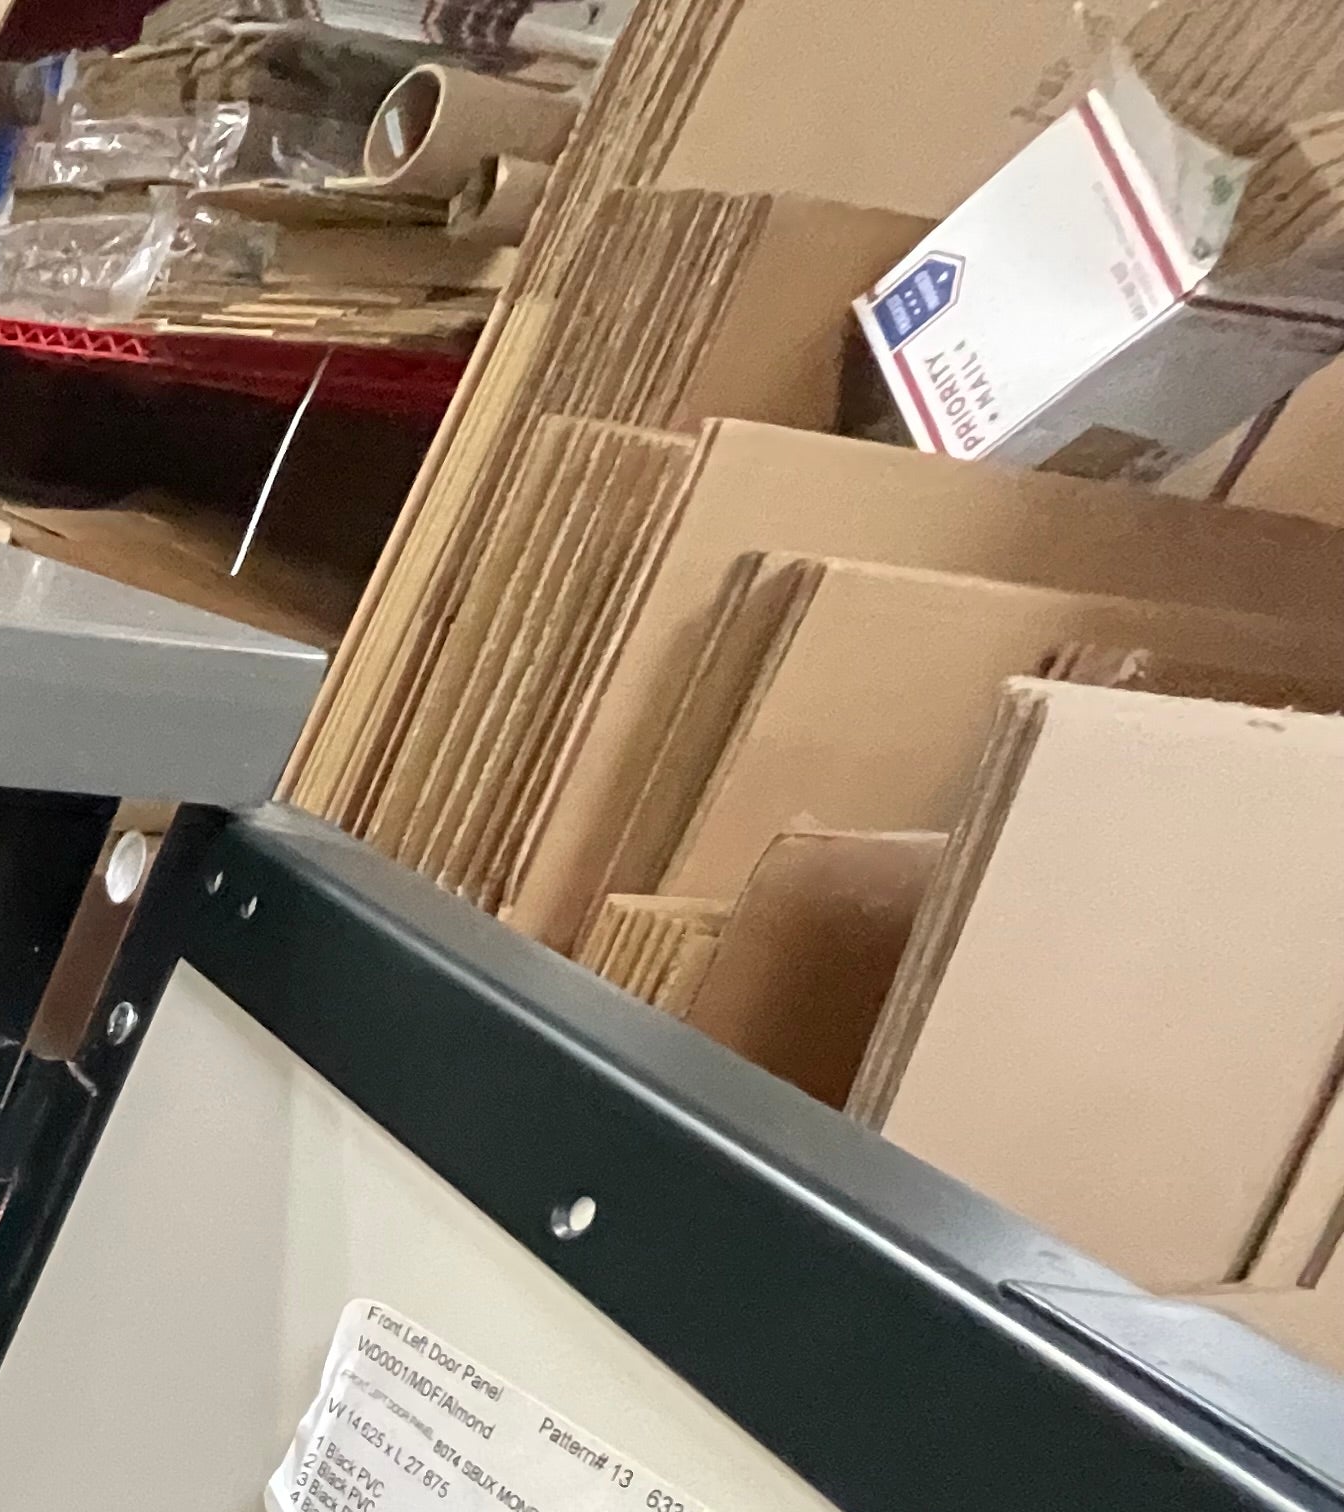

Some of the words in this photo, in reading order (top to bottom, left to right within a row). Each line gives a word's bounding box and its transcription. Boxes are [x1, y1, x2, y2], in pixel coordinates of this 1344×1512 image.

[925, 352, 985, 451] PRIORITY
[962, 352, 995, 410] MAIL
[367, 1306, 403, 1337] Front
[402, 1327, 428, 1354] Left
[428, 1343, 462, 1374] Door
[461, 1364, 505, 1402] Panel
[328, 1397, 347, 1418] W
[347, 1410, 386, 1448] 14625
[296, 1471, 309, 1486] 3
[304, 1453, 318, 1469] 2
[317, 1460, 347, 1496] Black
[316, 1435, 325, 1450] 1
[325, 1442, 357, 1477] Black
[356, 1466, 385, 1498] PVC
[433, 1439, 462, 1468] 8074
[462, 1460, 498, 1495] SBUX
[539, 1416, 609, 1470] Pattern#
[611, 1464, 634, 1488] 13
